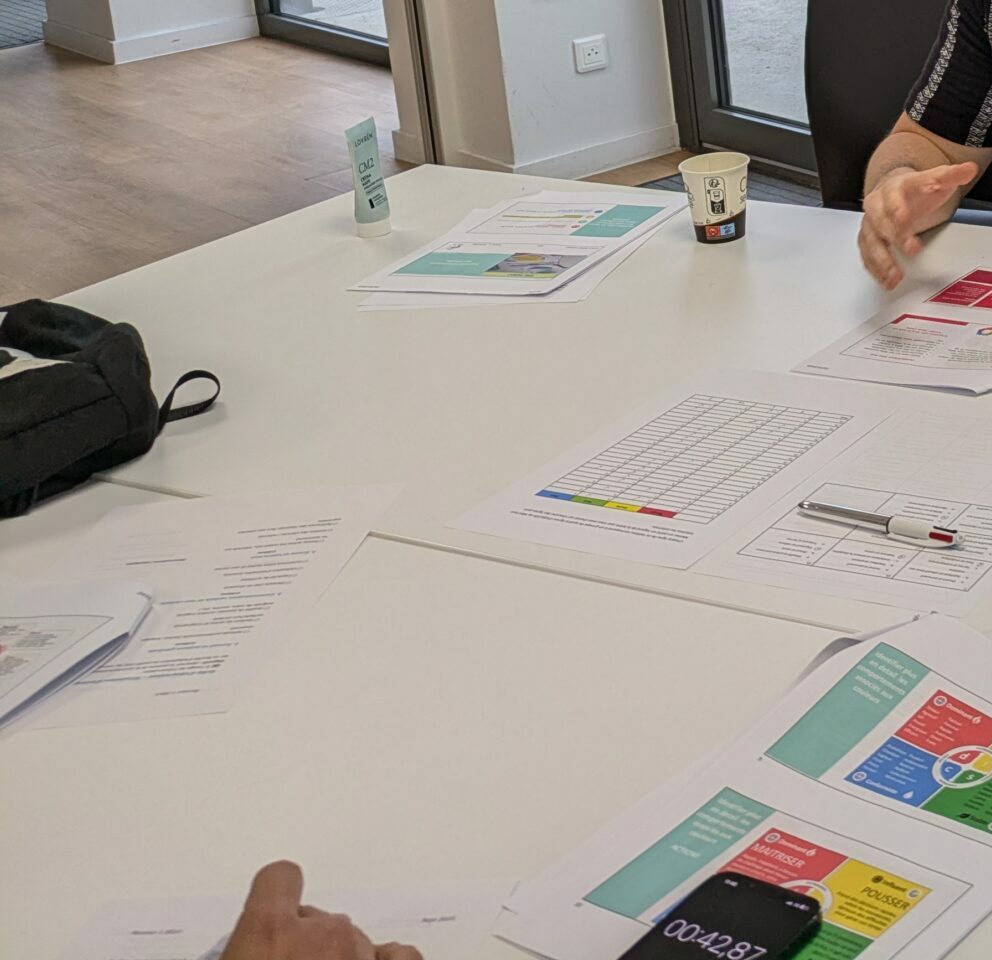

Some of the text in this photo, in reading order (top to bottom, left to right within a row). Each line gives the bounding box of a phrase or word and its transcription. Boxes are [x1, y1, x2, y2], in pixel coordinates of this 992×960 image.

[751, 843, 806, 868] MAITRISER
[860, 886, 910, 910] POUSSER
[663, 919, 767, 960] 00:42,87
